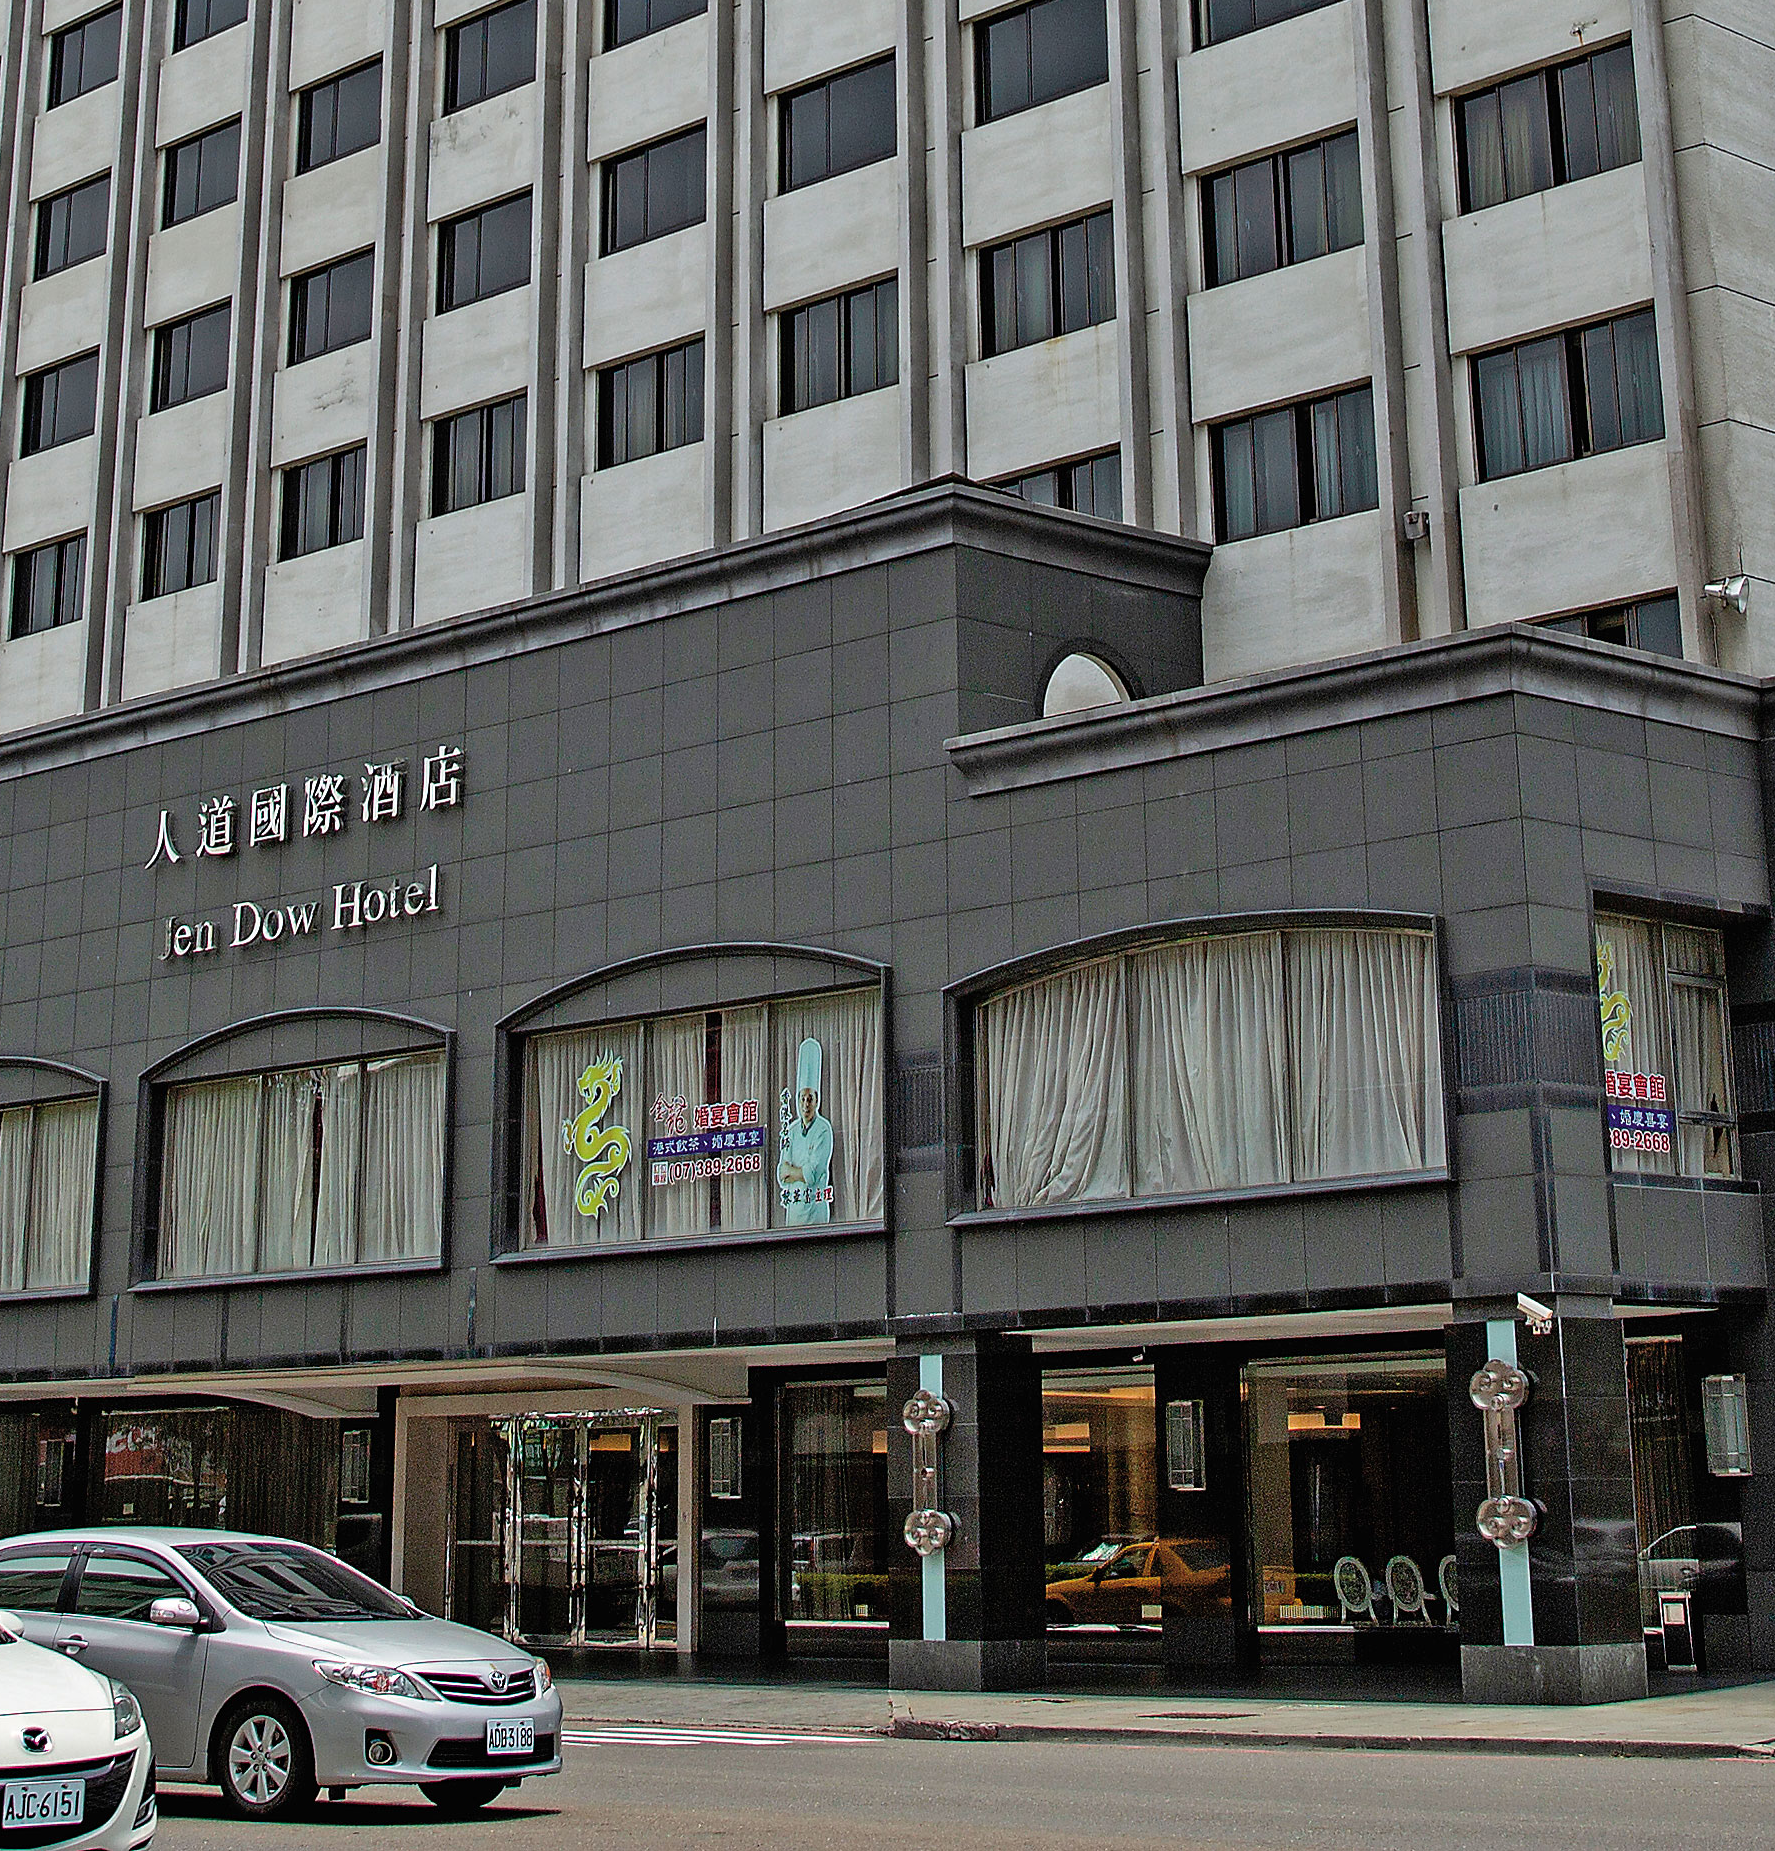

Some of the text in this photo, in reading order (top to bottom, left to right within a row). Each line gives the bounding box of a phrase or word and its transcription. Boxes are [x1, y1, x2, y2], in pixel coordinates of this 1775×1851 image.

[144, 745, 463, 869] 人道國際酒店
[158, 864, 440, 961] Jen Dow Hotel
[693, 1099, 758, 1129] 婚宴會館
[669, 1154, 761, 1183] (07)389-2668
